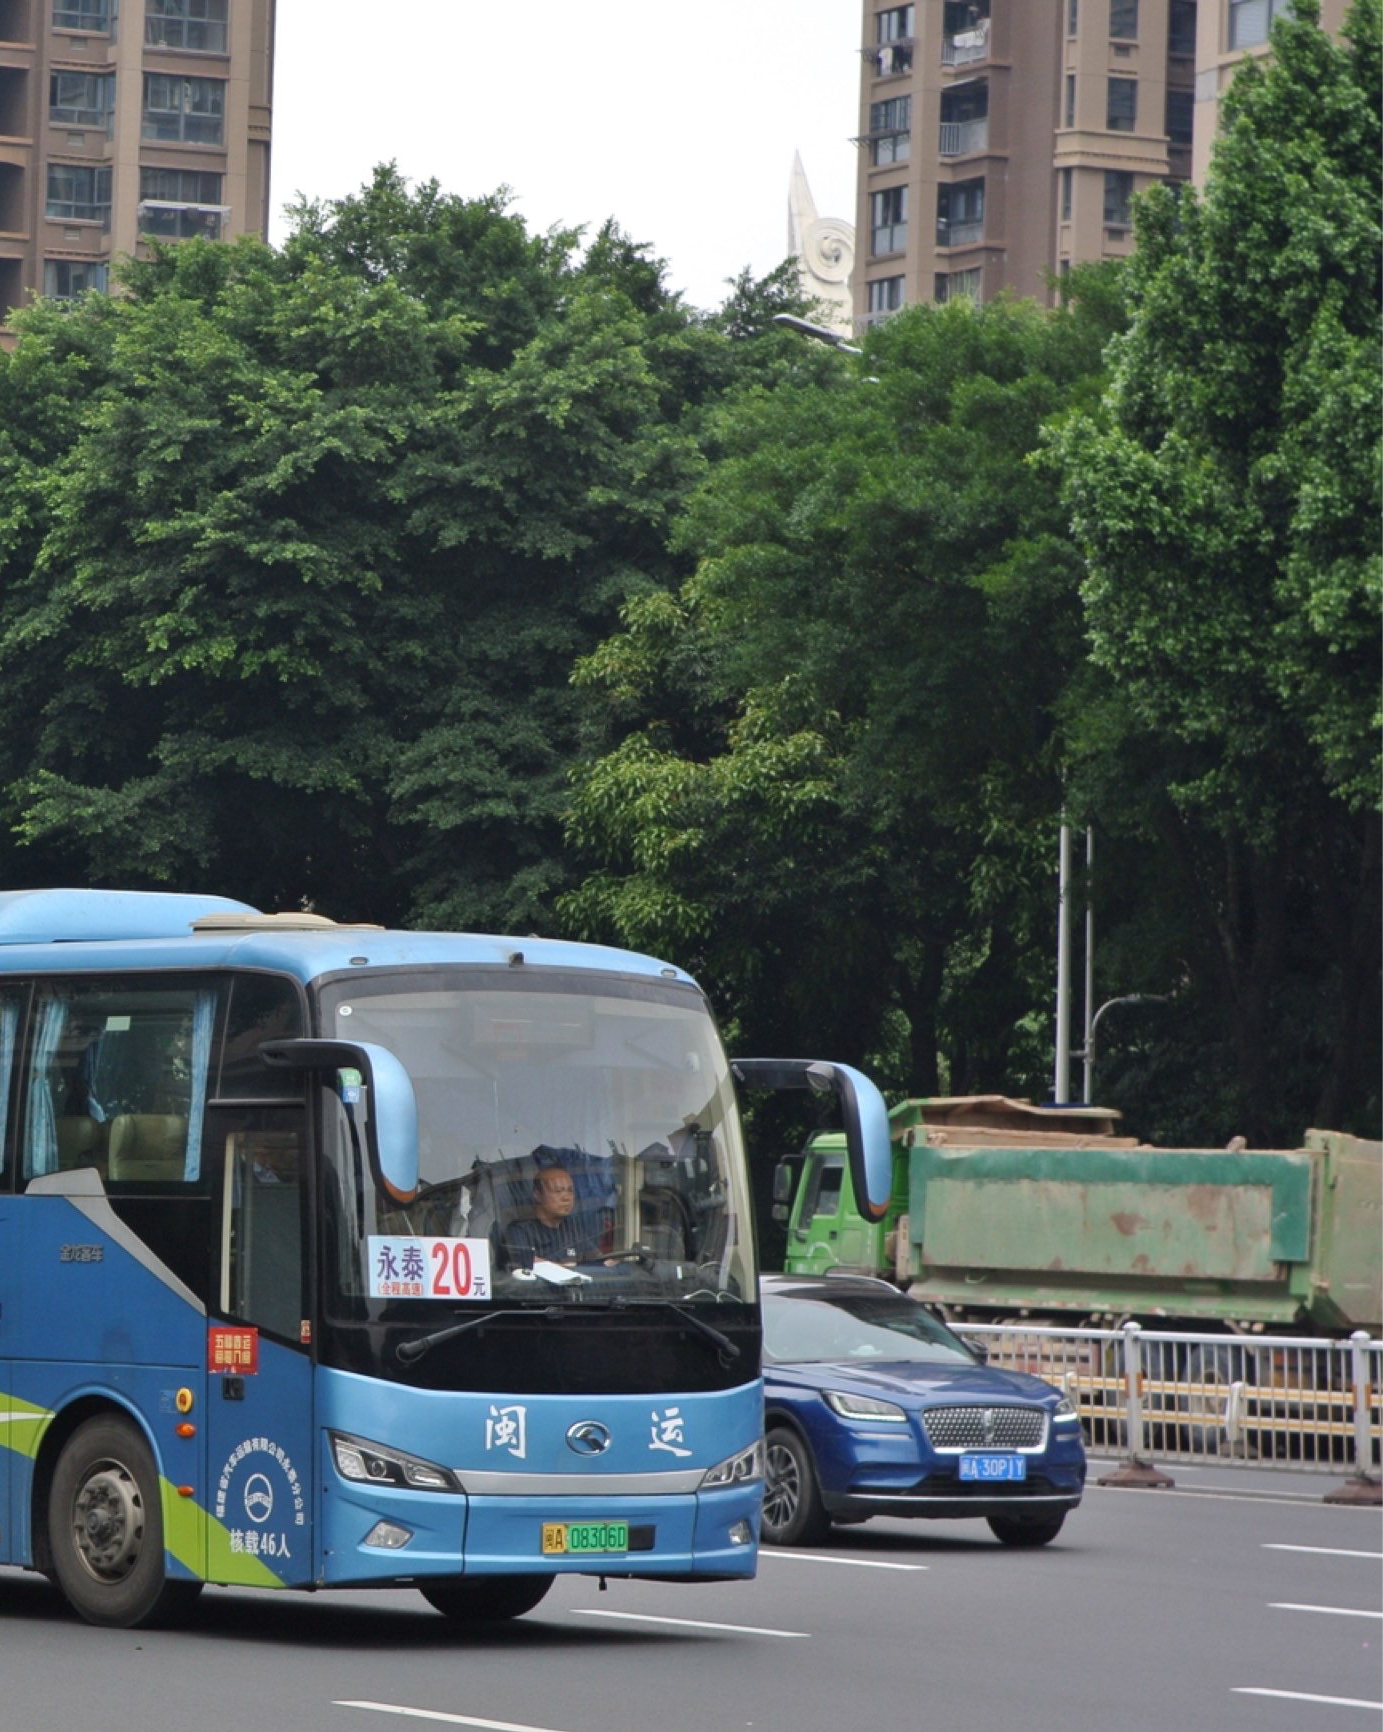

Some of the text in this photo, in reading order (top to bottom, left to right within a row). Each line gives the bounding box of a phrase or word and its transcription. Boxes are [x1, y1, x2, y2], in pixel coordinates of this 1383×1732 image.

[377, 1245, 424, 1281] 永泰
[484, 1404, 527, 1460] 闽
[648, 1407, 693, 1457] 运
[230, 1527, 291, 1558] 核载46人
